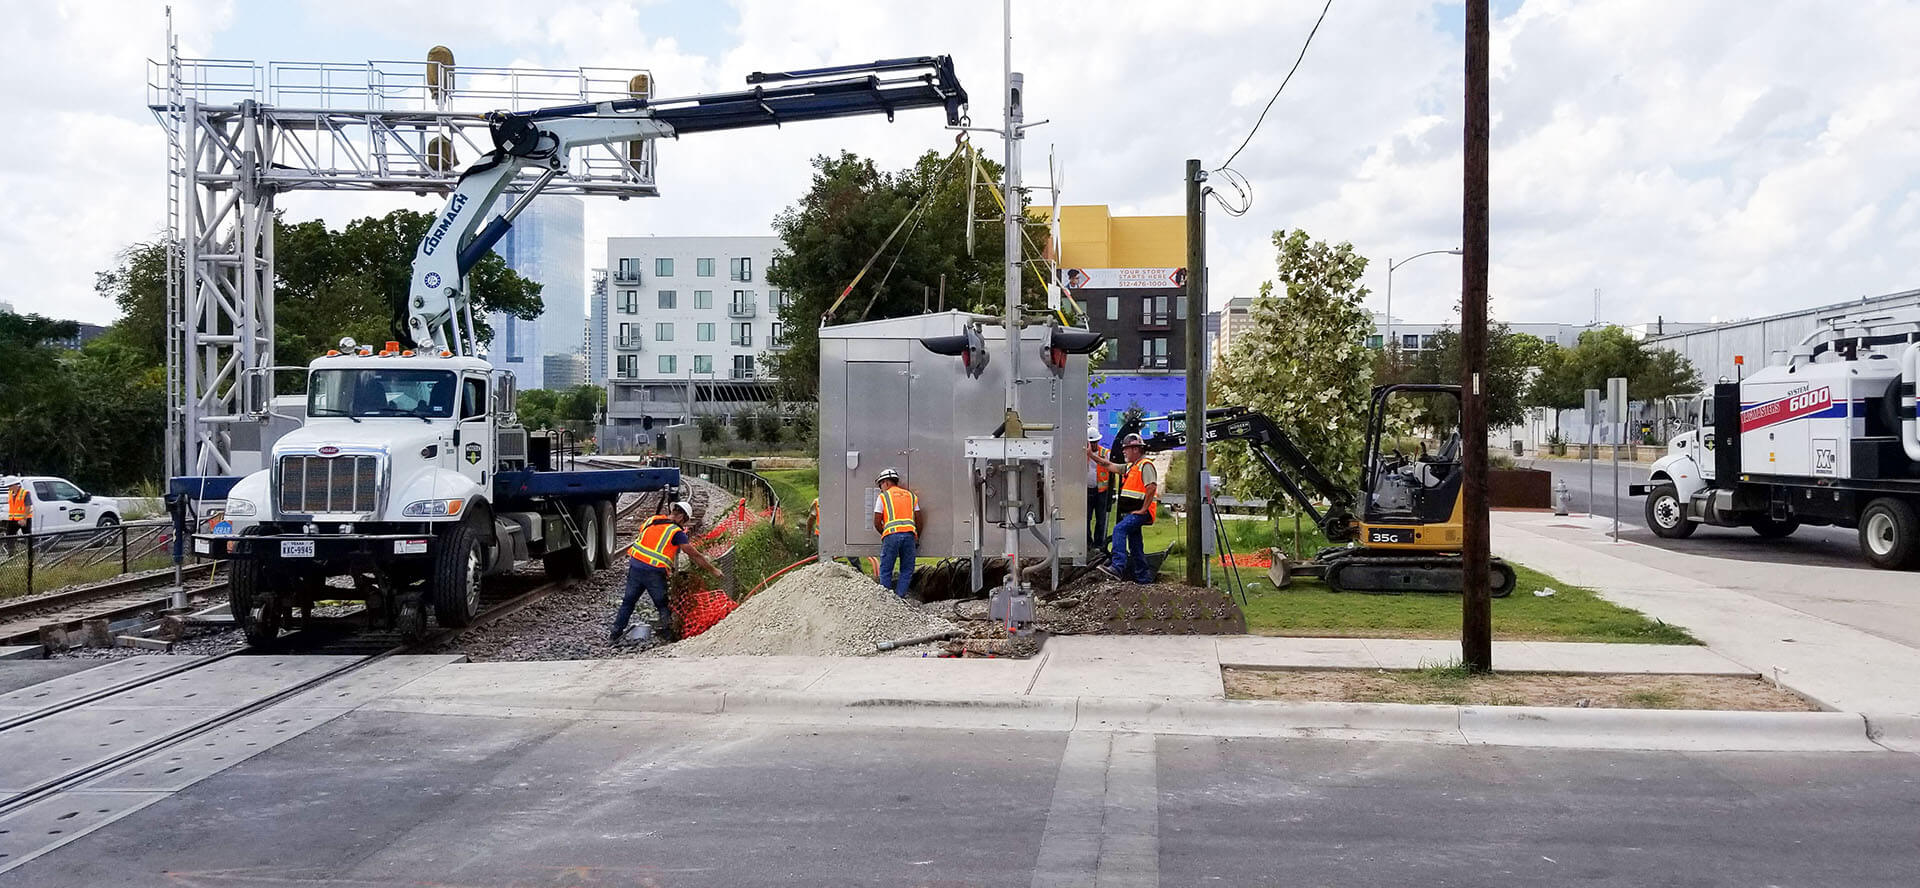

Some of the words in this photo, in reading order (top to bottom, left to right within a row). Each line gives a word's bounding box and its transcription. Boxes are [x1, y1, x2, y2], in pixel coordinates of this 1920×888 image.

[423, 193, 469, 256] CORMACH
[1787, 385, 1809, 397] SYSTEM
[1790, 388, 1829, 412] 6000
[1372, 533, 1398, 543] 35G
